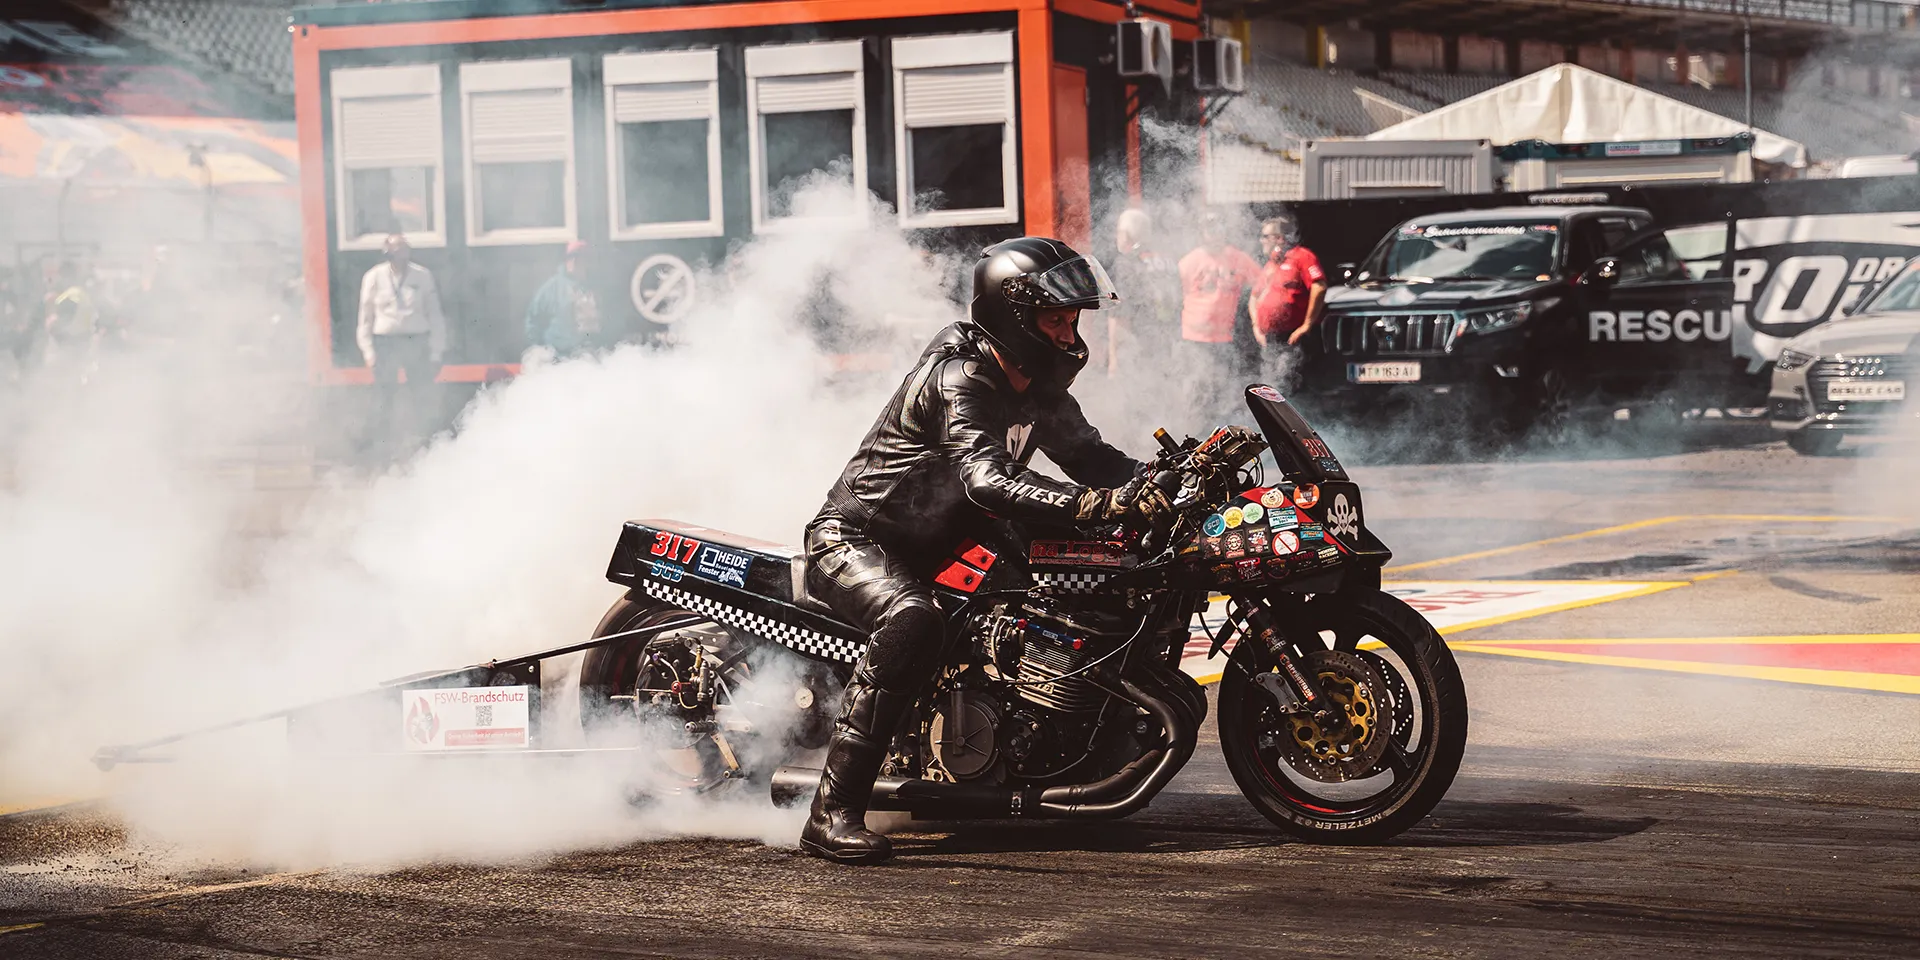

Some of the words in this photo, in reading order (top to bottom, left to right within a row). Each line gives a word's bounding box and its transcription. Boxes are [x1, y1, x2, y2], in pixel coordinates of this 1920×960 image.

[986, 473, 1073, 508] DAINESE
[650, 530, 701, 564] 317
[717, 550, 750, 569] HEIDE
[650, 560, 685, 583] SCB
[698, 565, 720, 577] Fenster
[434, 691, 525, 705] FSW-Brandschutz
[1315, 812, 1382, 830] METZELER
